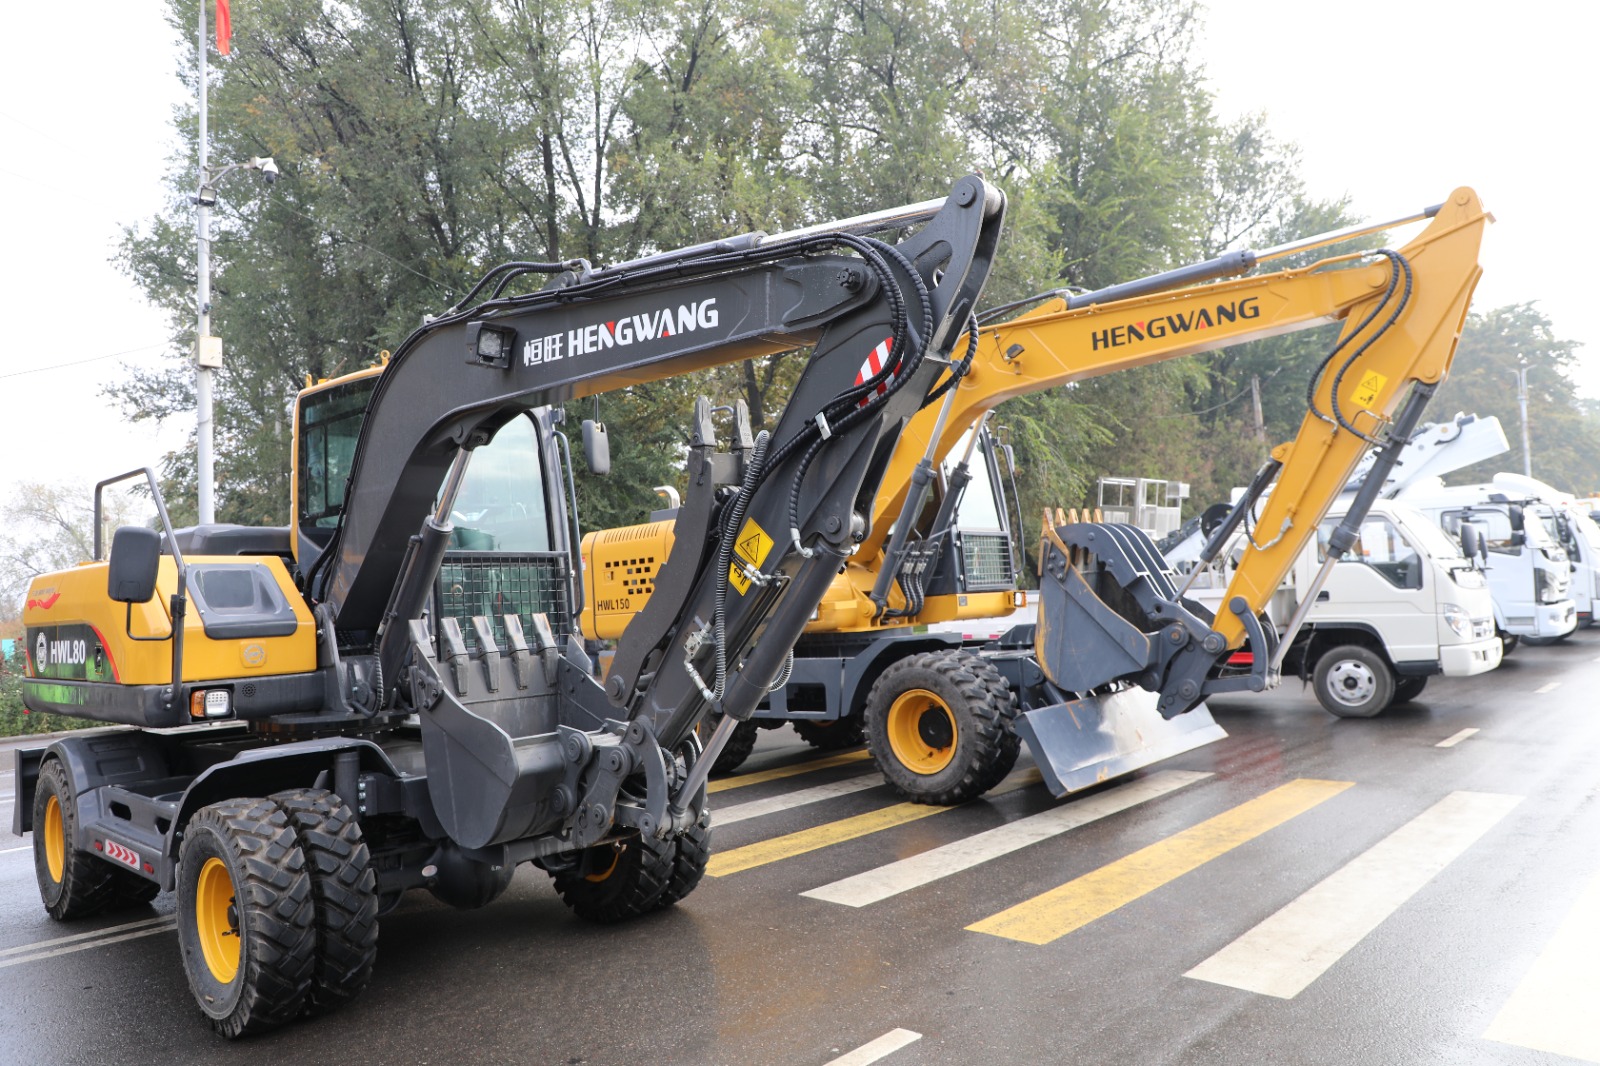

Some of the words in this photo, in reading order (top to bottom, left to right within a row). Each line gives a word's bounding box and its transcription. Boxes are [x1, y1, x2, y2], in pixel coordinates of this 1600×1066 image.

[523, 332, 564, 367] 恒旺
[567, 297, 719, 358] HENGWANG
[1091, 296, 1260, 351] HENGWANG
[597, 598, 630, 611] HWL150
[50, 639, 86, 665] HWL80
